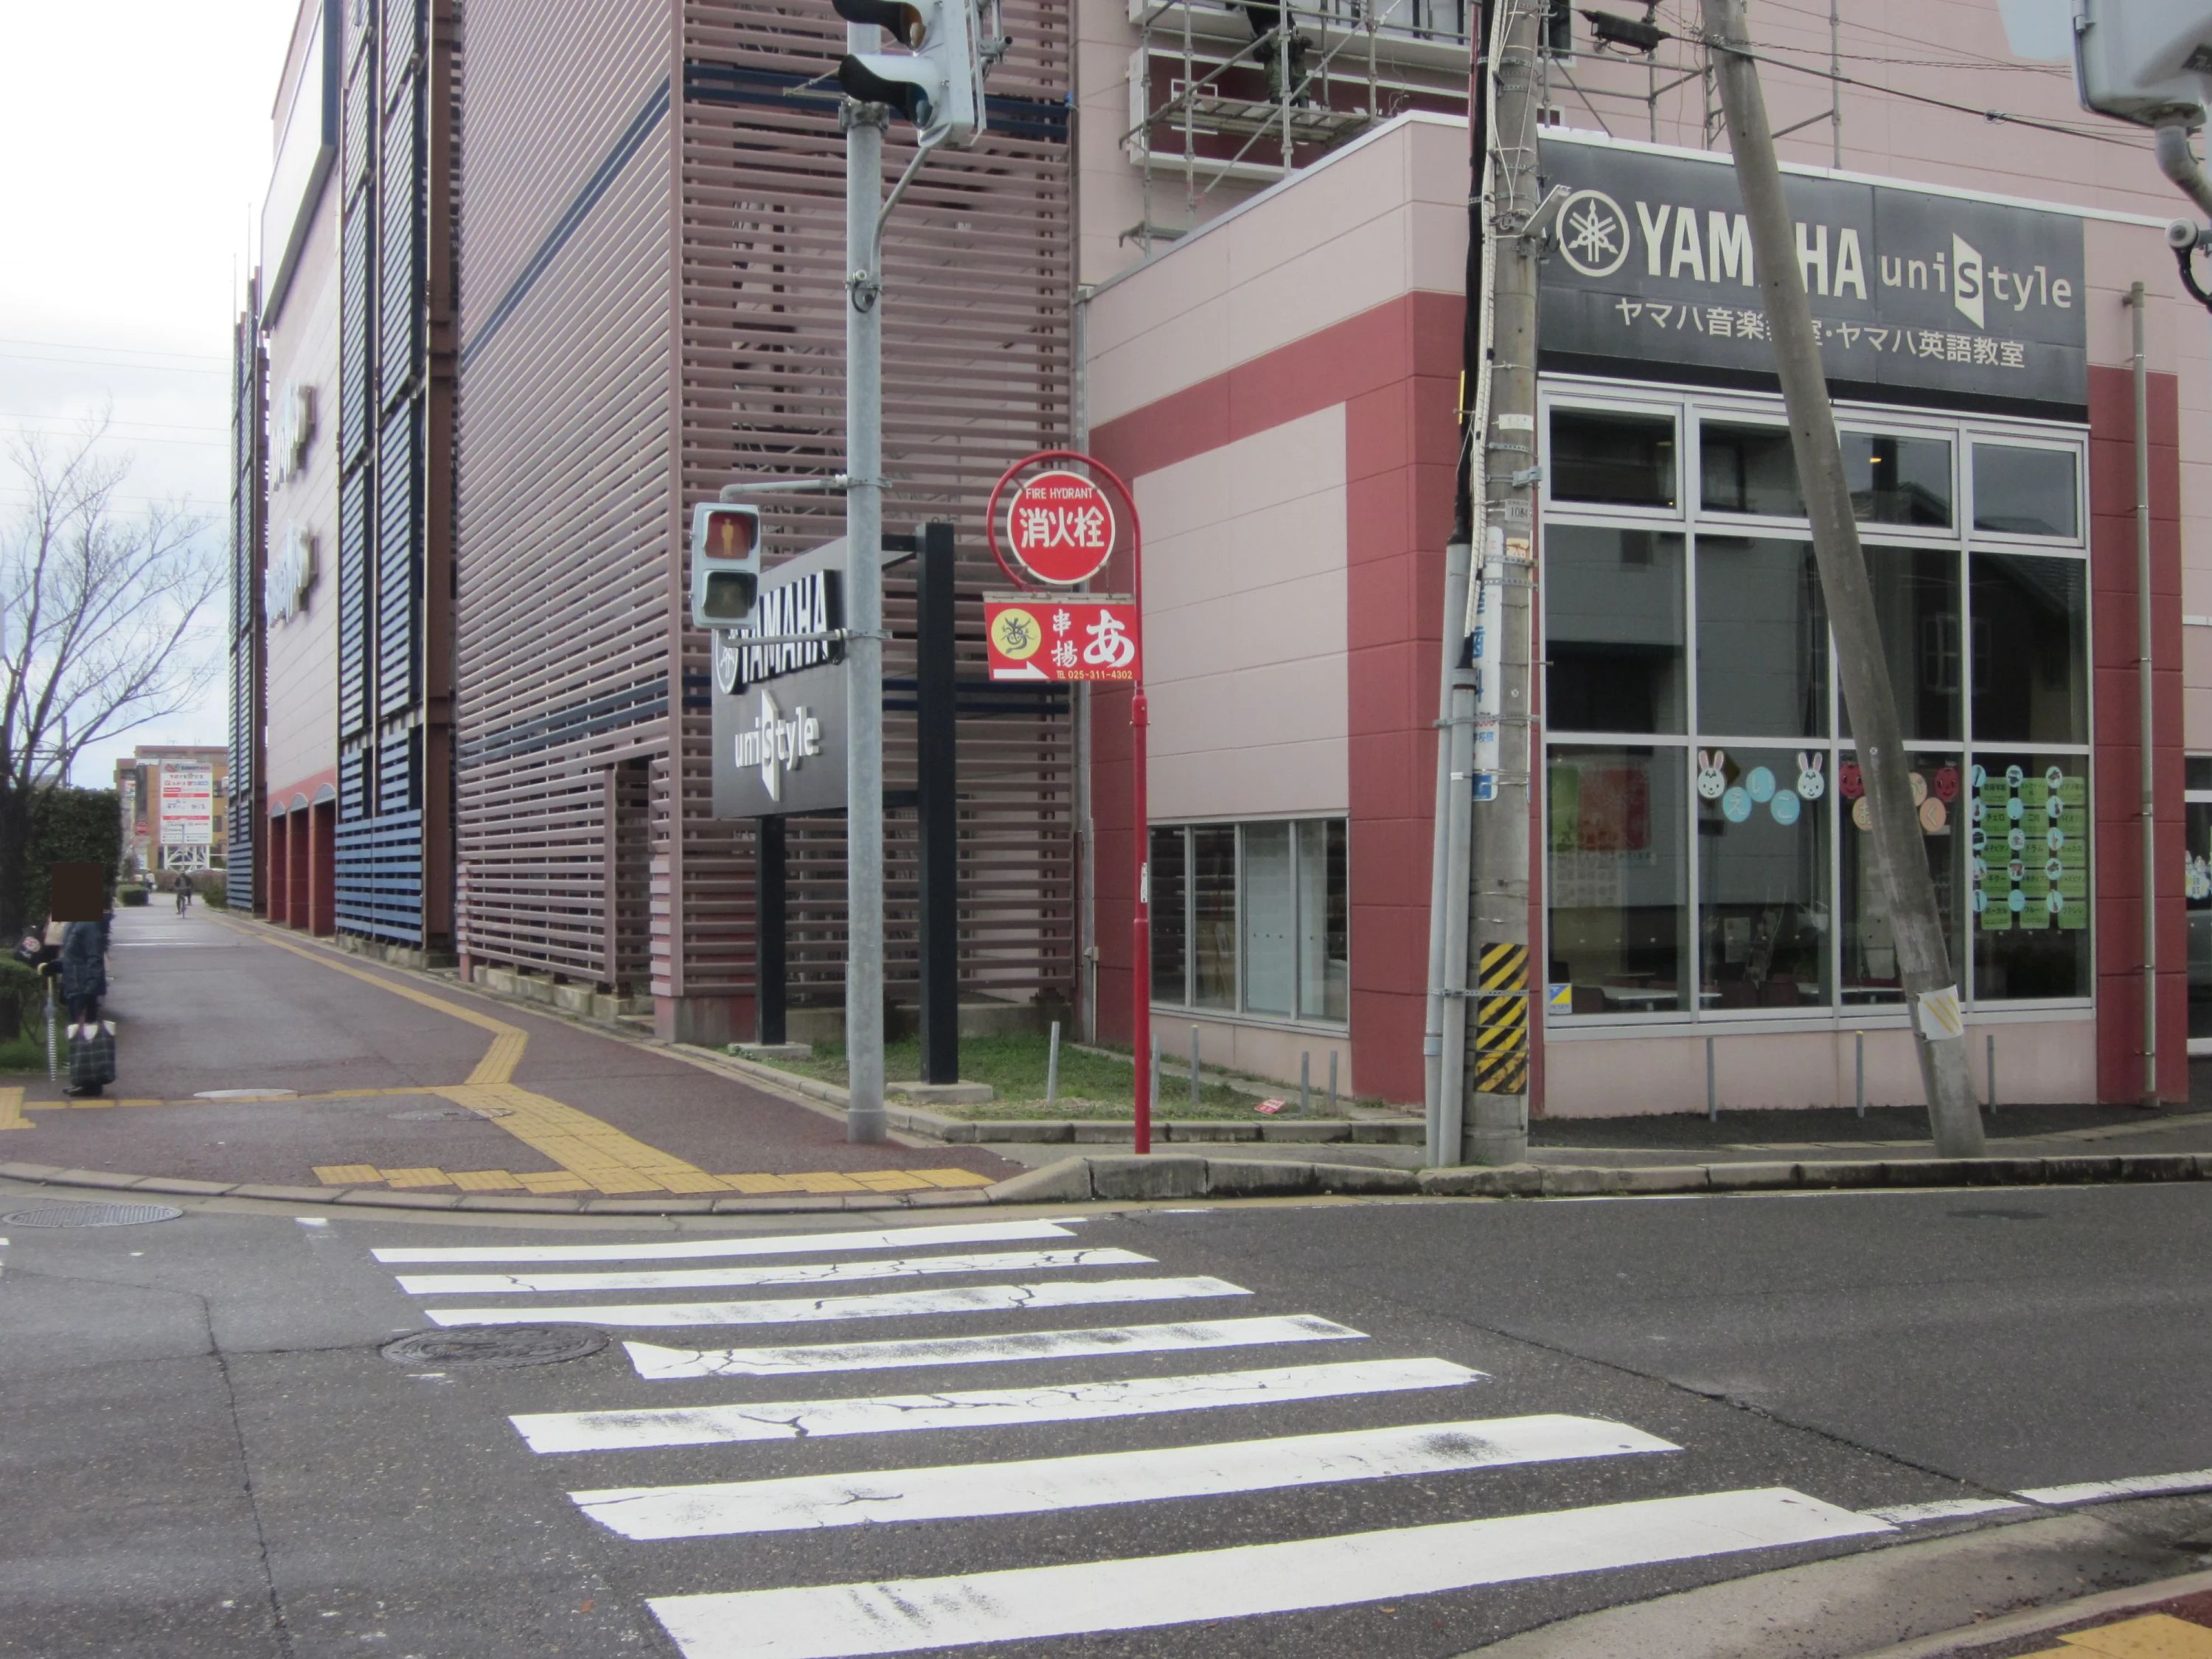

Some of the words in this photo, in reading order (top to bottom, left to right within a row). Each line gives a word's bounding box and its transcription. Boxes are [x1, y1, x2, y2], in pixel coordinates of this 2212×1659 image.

[1635, 201, 1868, 301] YAMHA
[1615, 297, 2025, 369] ヤマハ音楽・ヤマハ英語教室
[1026, 487, 1047, 500] FIRE
[1050, 487, 1093, 500] HYDRANT
[1019, 506, 1105, 548] 消火栓
[1051, 608, 1078, 668] 串揚
[1083, 609, 1135, 668] あ
[1068, 670, 1133, 679] 025-311-4302
